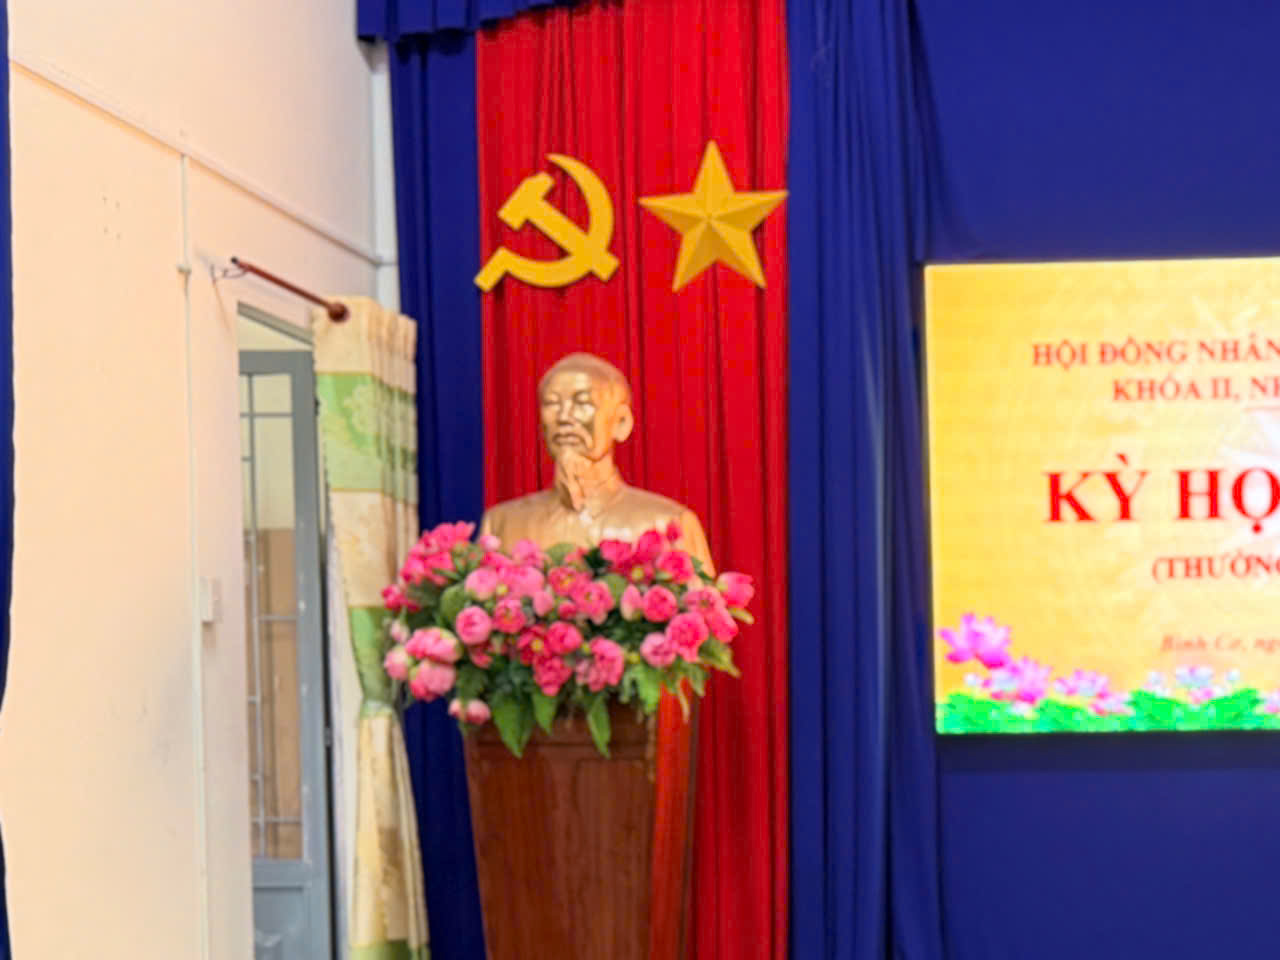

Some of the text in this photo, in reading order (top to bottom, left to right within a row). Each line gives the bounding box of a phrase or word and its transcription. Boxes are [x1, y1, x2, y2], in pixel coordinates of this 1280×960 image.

[1032, 339, 1088, 371] HỘI
[1112, 371, 1201, 401] KHÓA
[1211, 377, 1240, 402] II,
[1043, 453, 1150, 523] KỲ
